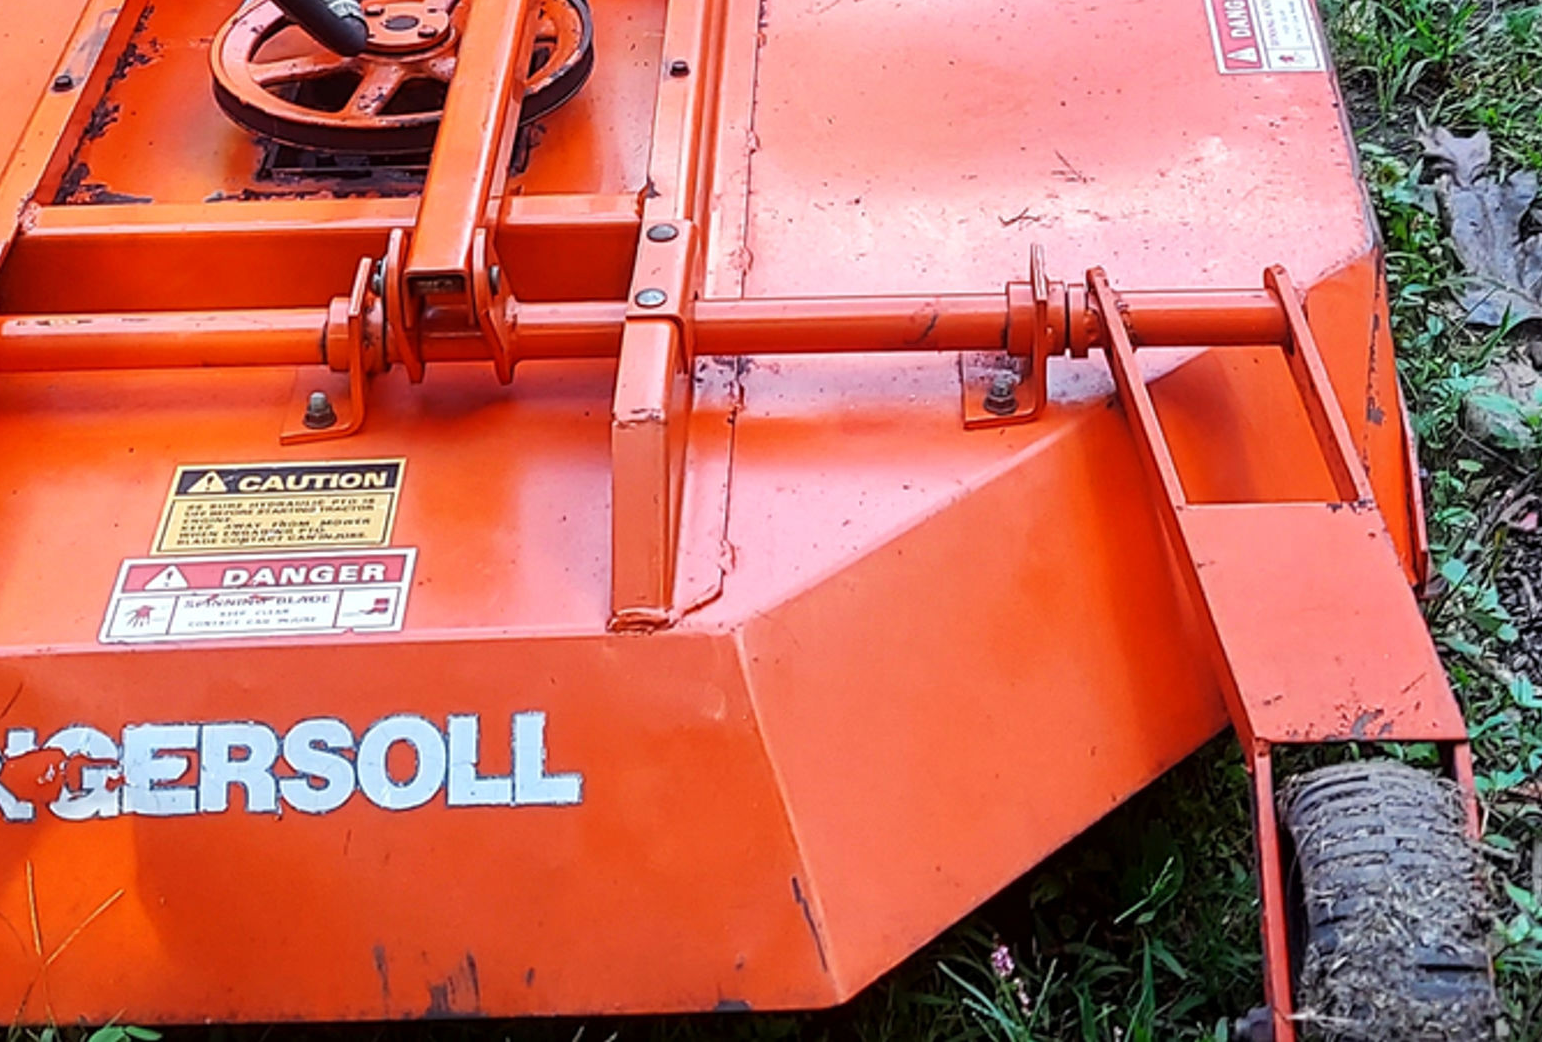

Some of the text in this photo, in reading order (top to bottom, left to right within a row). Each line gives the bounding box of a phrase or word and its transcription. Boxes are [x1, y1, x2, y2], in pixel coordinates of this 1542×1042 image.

[238, 469, 388, 493] CAUTION
[222, 562, 386, 588] DANGER
[276, 594, 331, 605] BLADE
